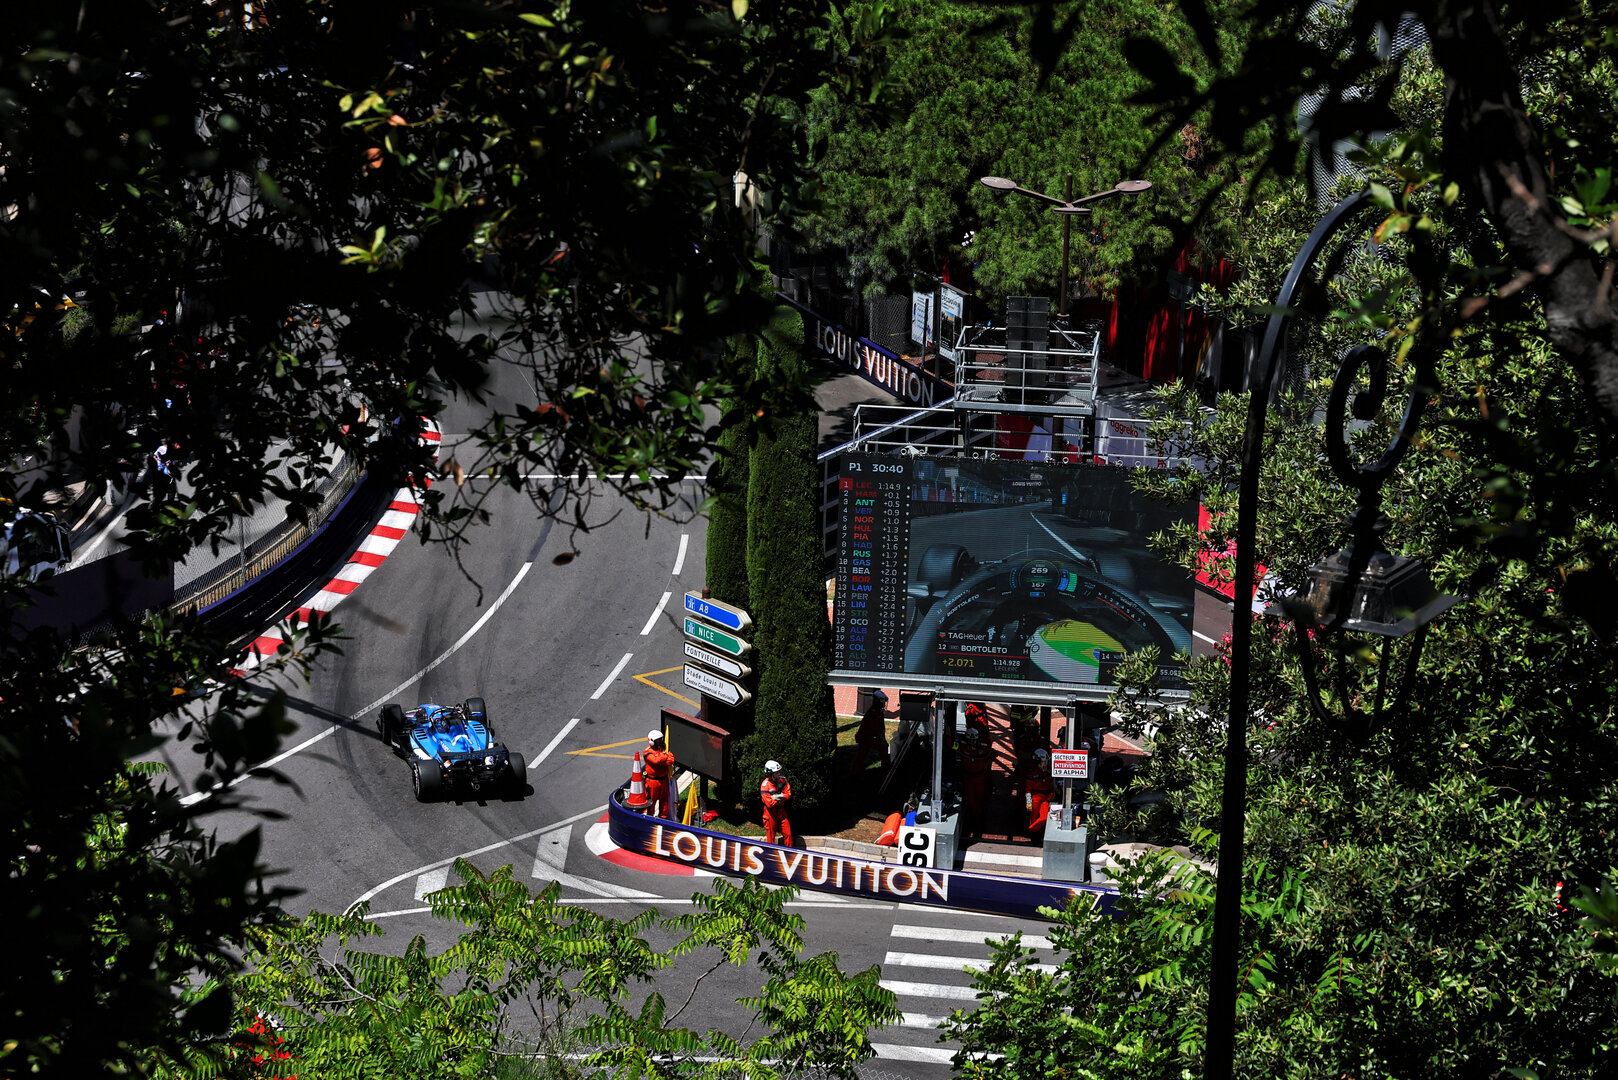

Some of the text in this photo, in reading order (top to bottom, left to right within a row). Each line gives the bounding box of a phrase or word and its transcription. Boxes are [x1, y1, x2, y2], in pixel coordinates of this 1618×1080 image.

[816, 320, 934, 407] LOUIS VUITTON
[1110, 420, 1138, 437] aggreko
[849, 463, 903, 473] P1 30:40
[699, 603, 709, 614] A8
[698, 627, 714, 641] NICE
[687, 646, 720, 666] FONTVIEILLE
[961, 645, 1008, 654] BORTOLETO
[942, 658, 974, 668] +2.071
[686, 669, 701, 679] Stade
[704, 676, 716, 686] Louis
[903, 832, 929, 867] SC
[655, 825, 949, 902] LOUIS VUITTON
